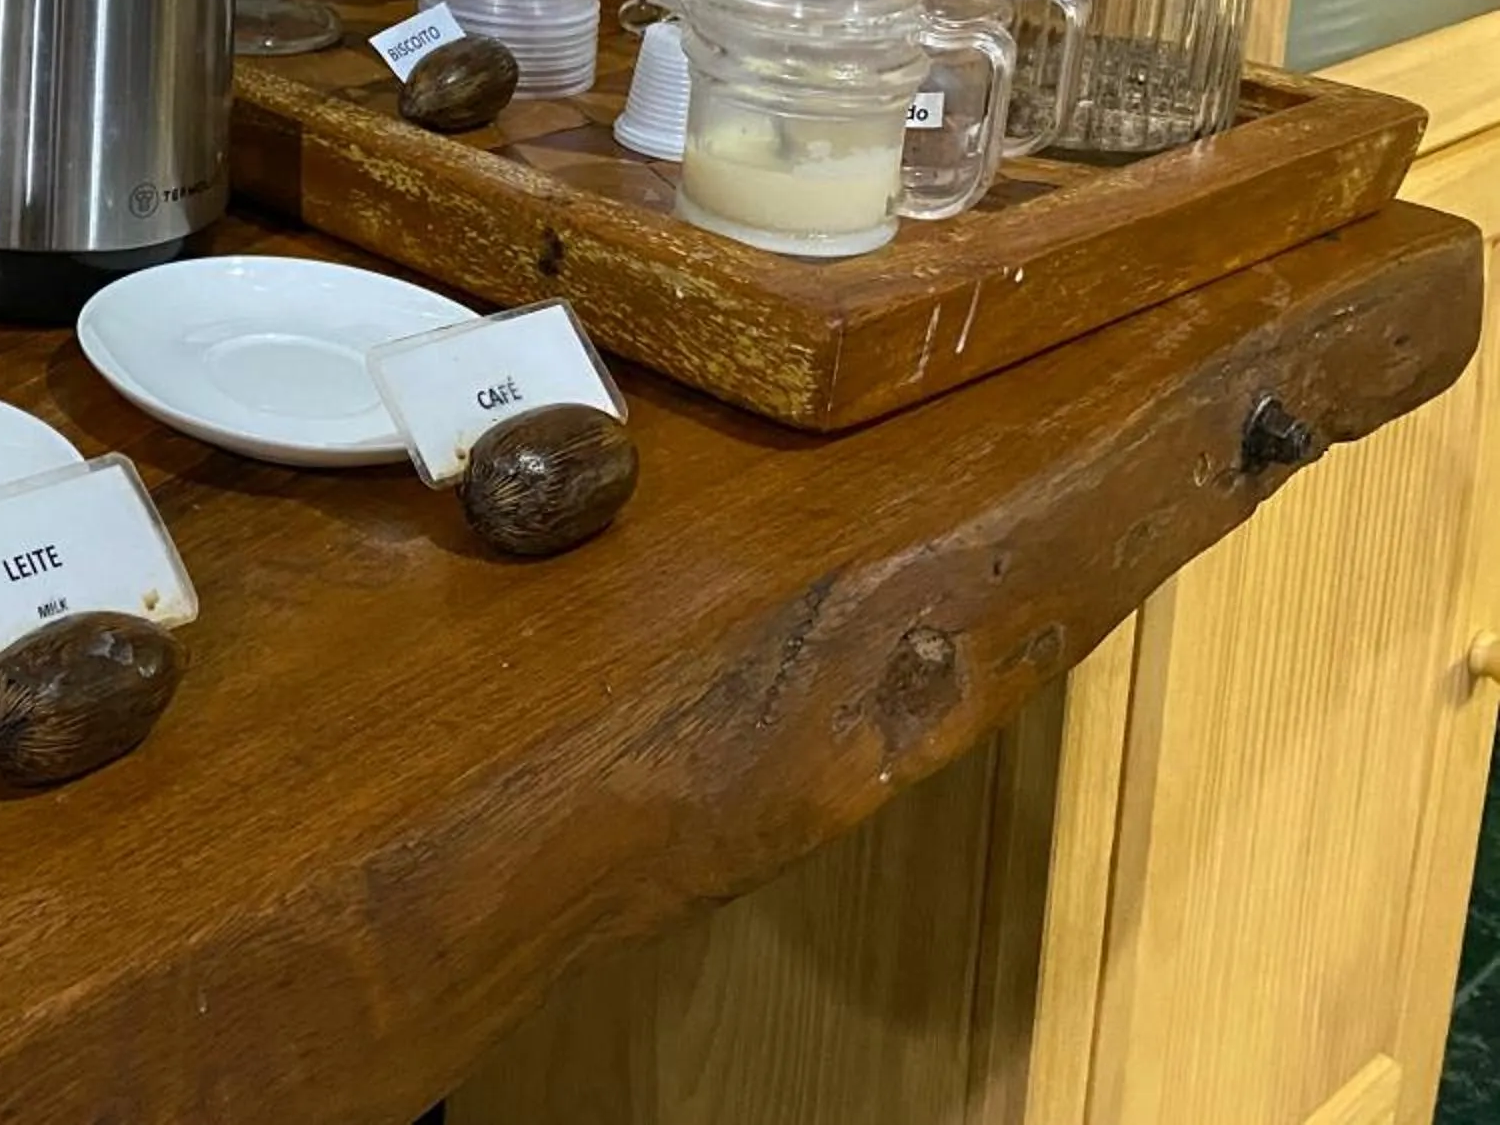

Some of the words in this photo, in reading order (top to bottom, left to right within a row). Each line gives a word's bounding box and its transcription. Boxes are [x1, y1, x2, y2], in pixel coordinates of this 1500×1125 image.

[387, 26, 441, 62] BISCOITO
[477, 375, 522, 410] CAFÉ
[2, 544, 63, 582] LEITE
[37, 596, 69, 620] MILK
